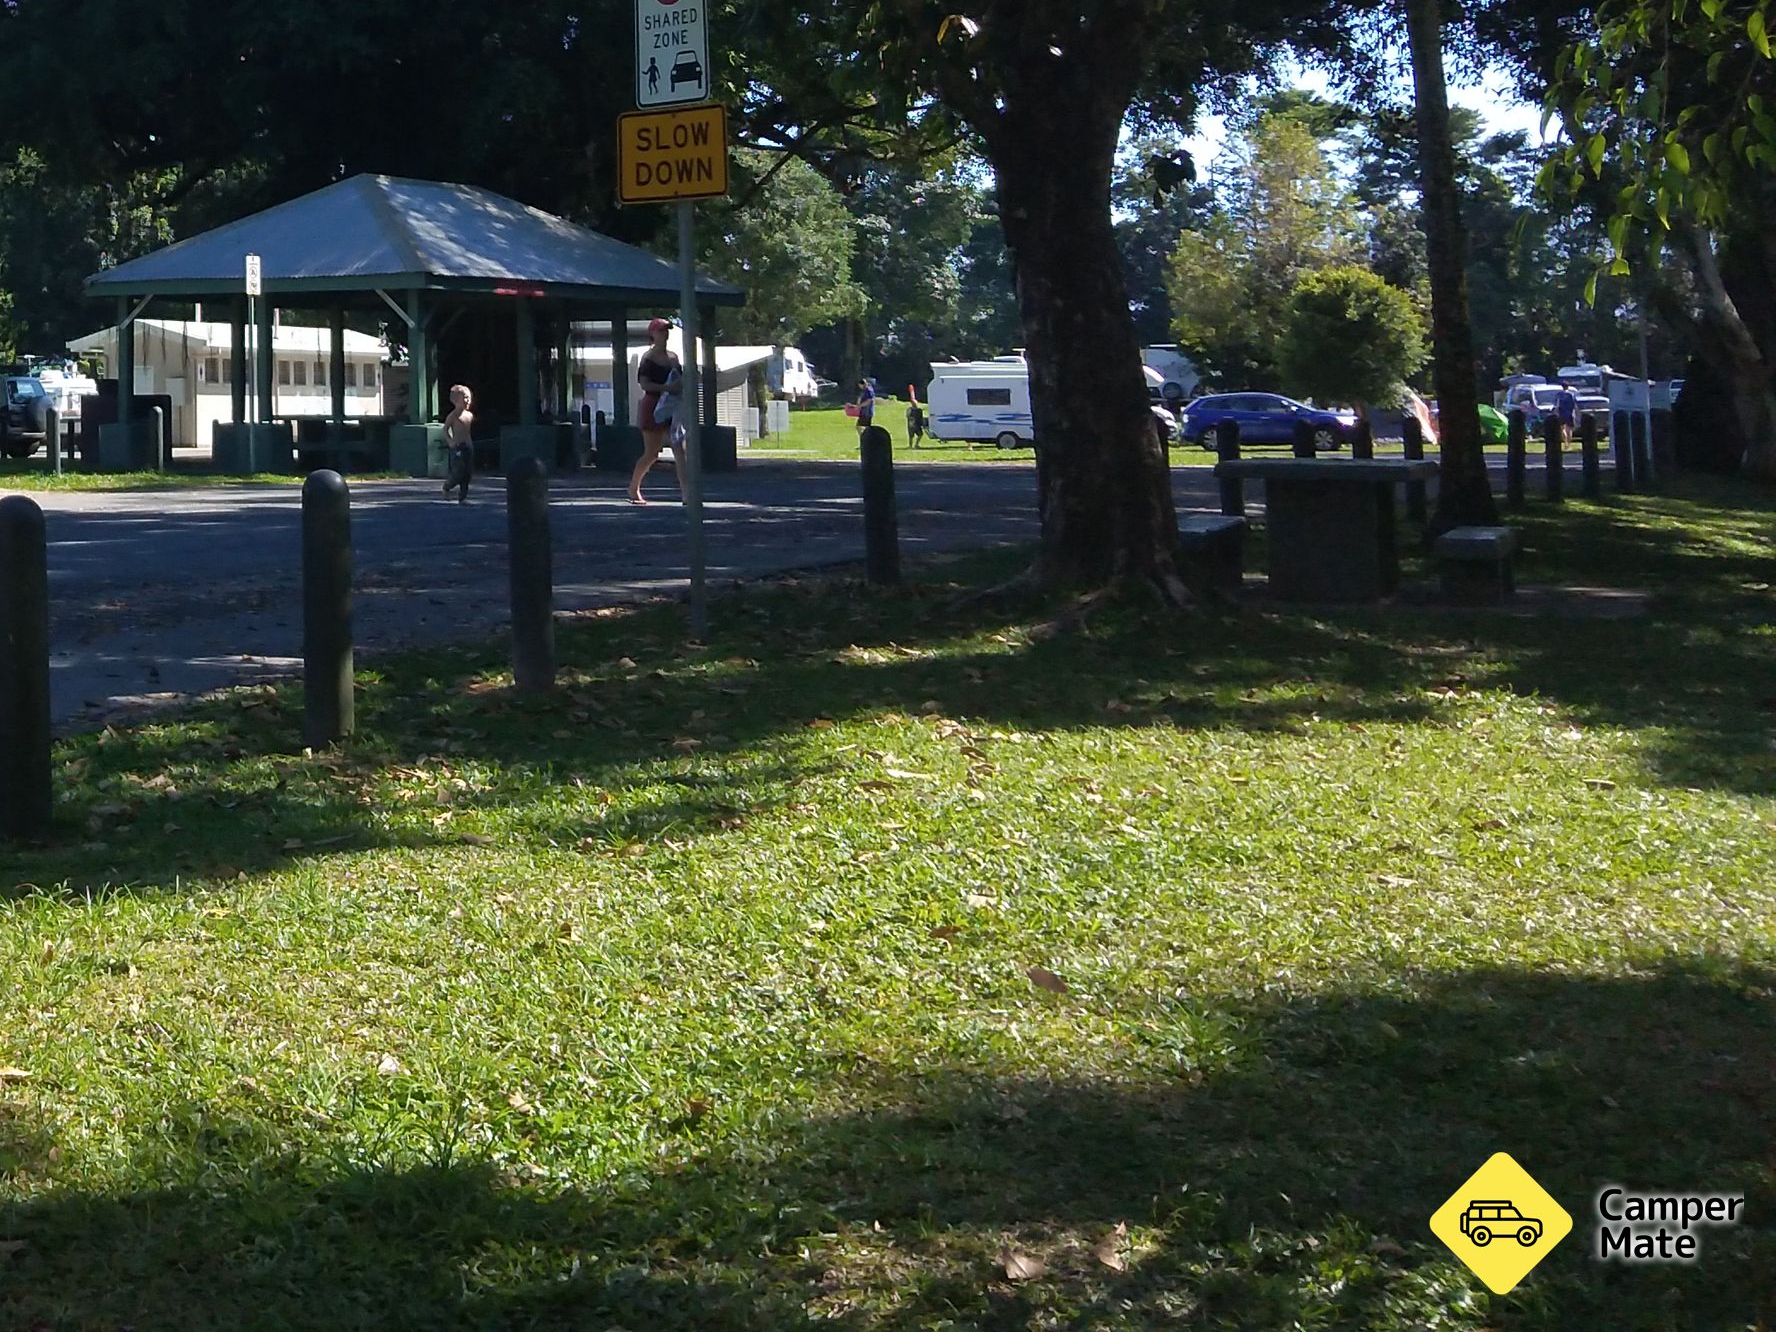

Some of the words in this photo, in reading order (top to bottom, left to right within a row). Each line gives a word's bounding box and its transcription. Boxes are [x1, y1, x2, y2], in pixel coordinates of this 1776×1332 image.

[644, 8, 698, 31] SHARED
[653, 29, 689, 49] ZONE
[636, 121, 709, 152] SLOW
[635, 156, 713, 187] DOWN
